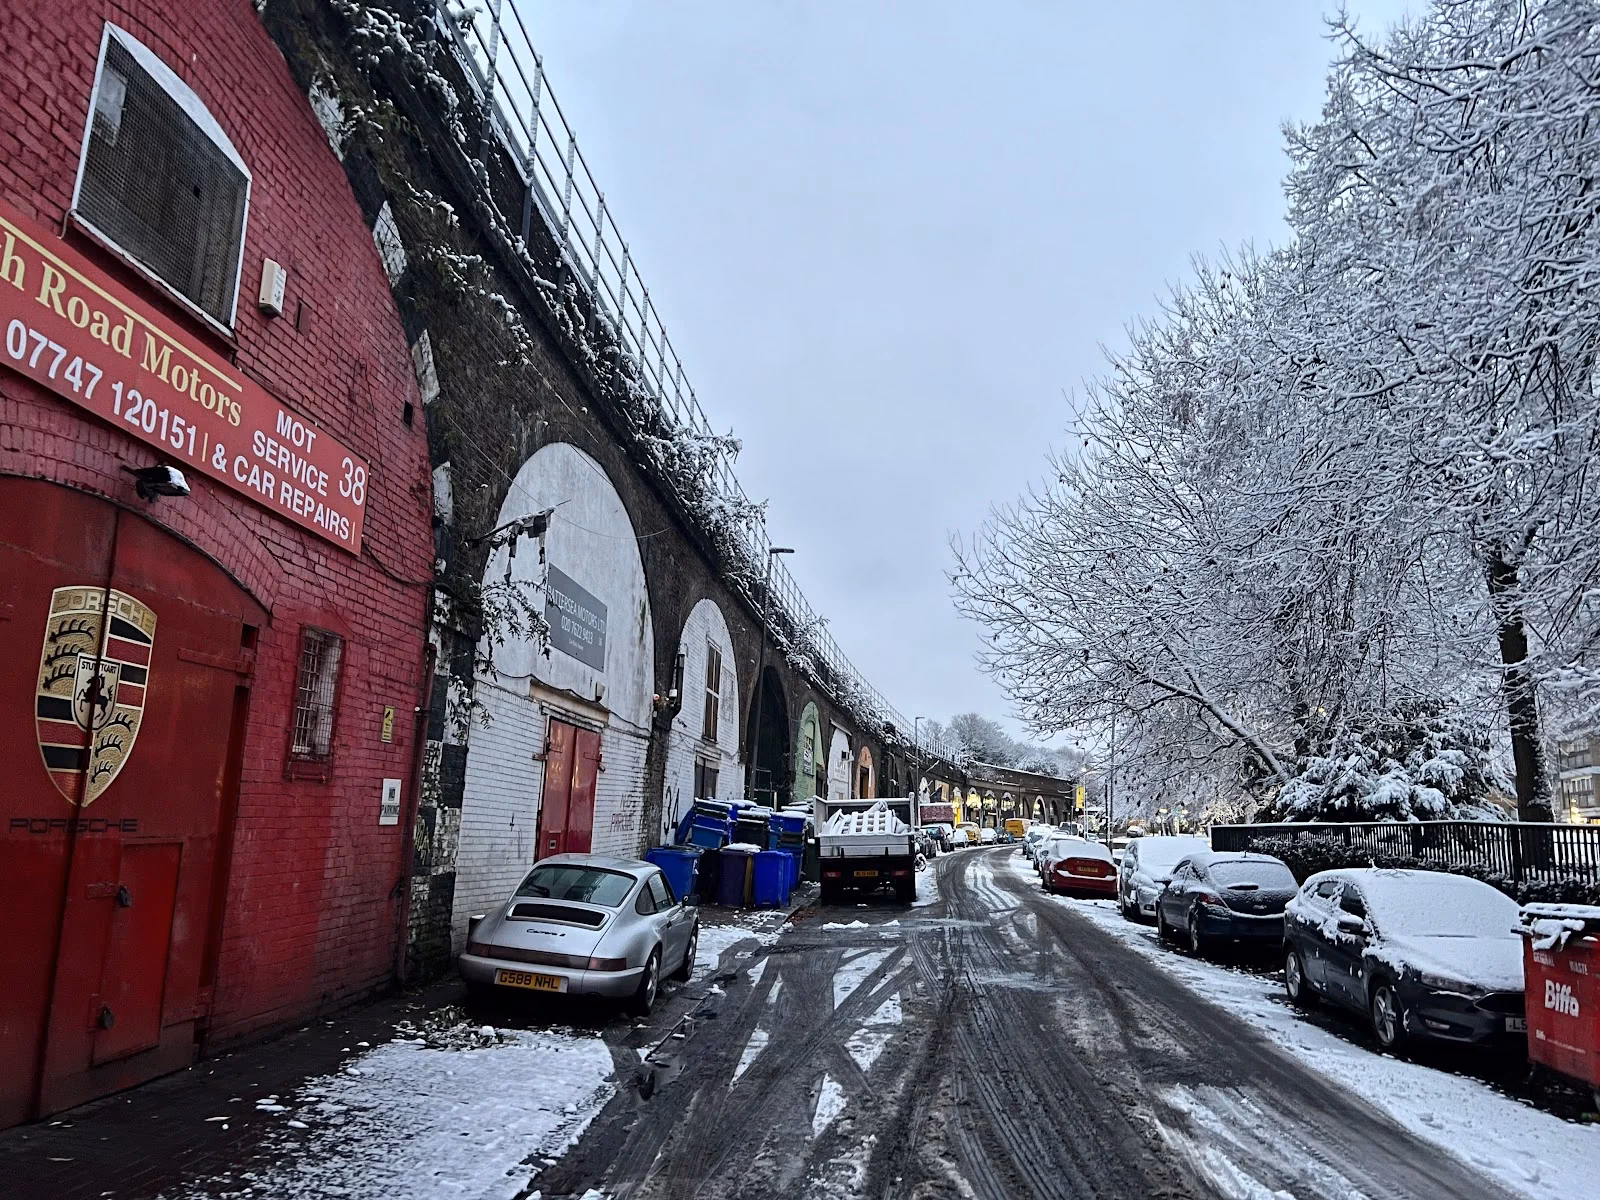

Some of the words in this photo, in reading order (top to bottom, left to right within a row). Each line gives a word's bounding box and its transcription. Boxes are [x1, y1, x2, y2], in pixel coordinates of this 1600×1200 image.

[0, 231, 25, 291] h
[35, 261, 134, 359] Road
[140, 331, 242, 427] Motors
[6, 319, 103, 400] 07747
[112, 381, 197, 456] 120151
[276, 409, 317, 453] MOT
[252, 430, 329, 497] SERVICE
[339, 457, 366, 506] 38
[212, 443, 227, 473] &
[233, 455, 276, 499] CAR
[280, 481, 350, 540] REPAIRS
[54, 590, 155, 635] PORSCHE
[547, 584, 577, 616] BATTERSEA
[577, 604, 598, 629] MOTORS
[597, 618, 606, 634] LTD
[9, 818, 138, 834] PORSCHE
[663, 785, 680, 836] 34
[500, 971, 532, 985] G588
[534, 975, 558, 989] NHL
[1569, 960, 1589, 976] WASTE
[1544, 979, 1580, 1018] Biffa
